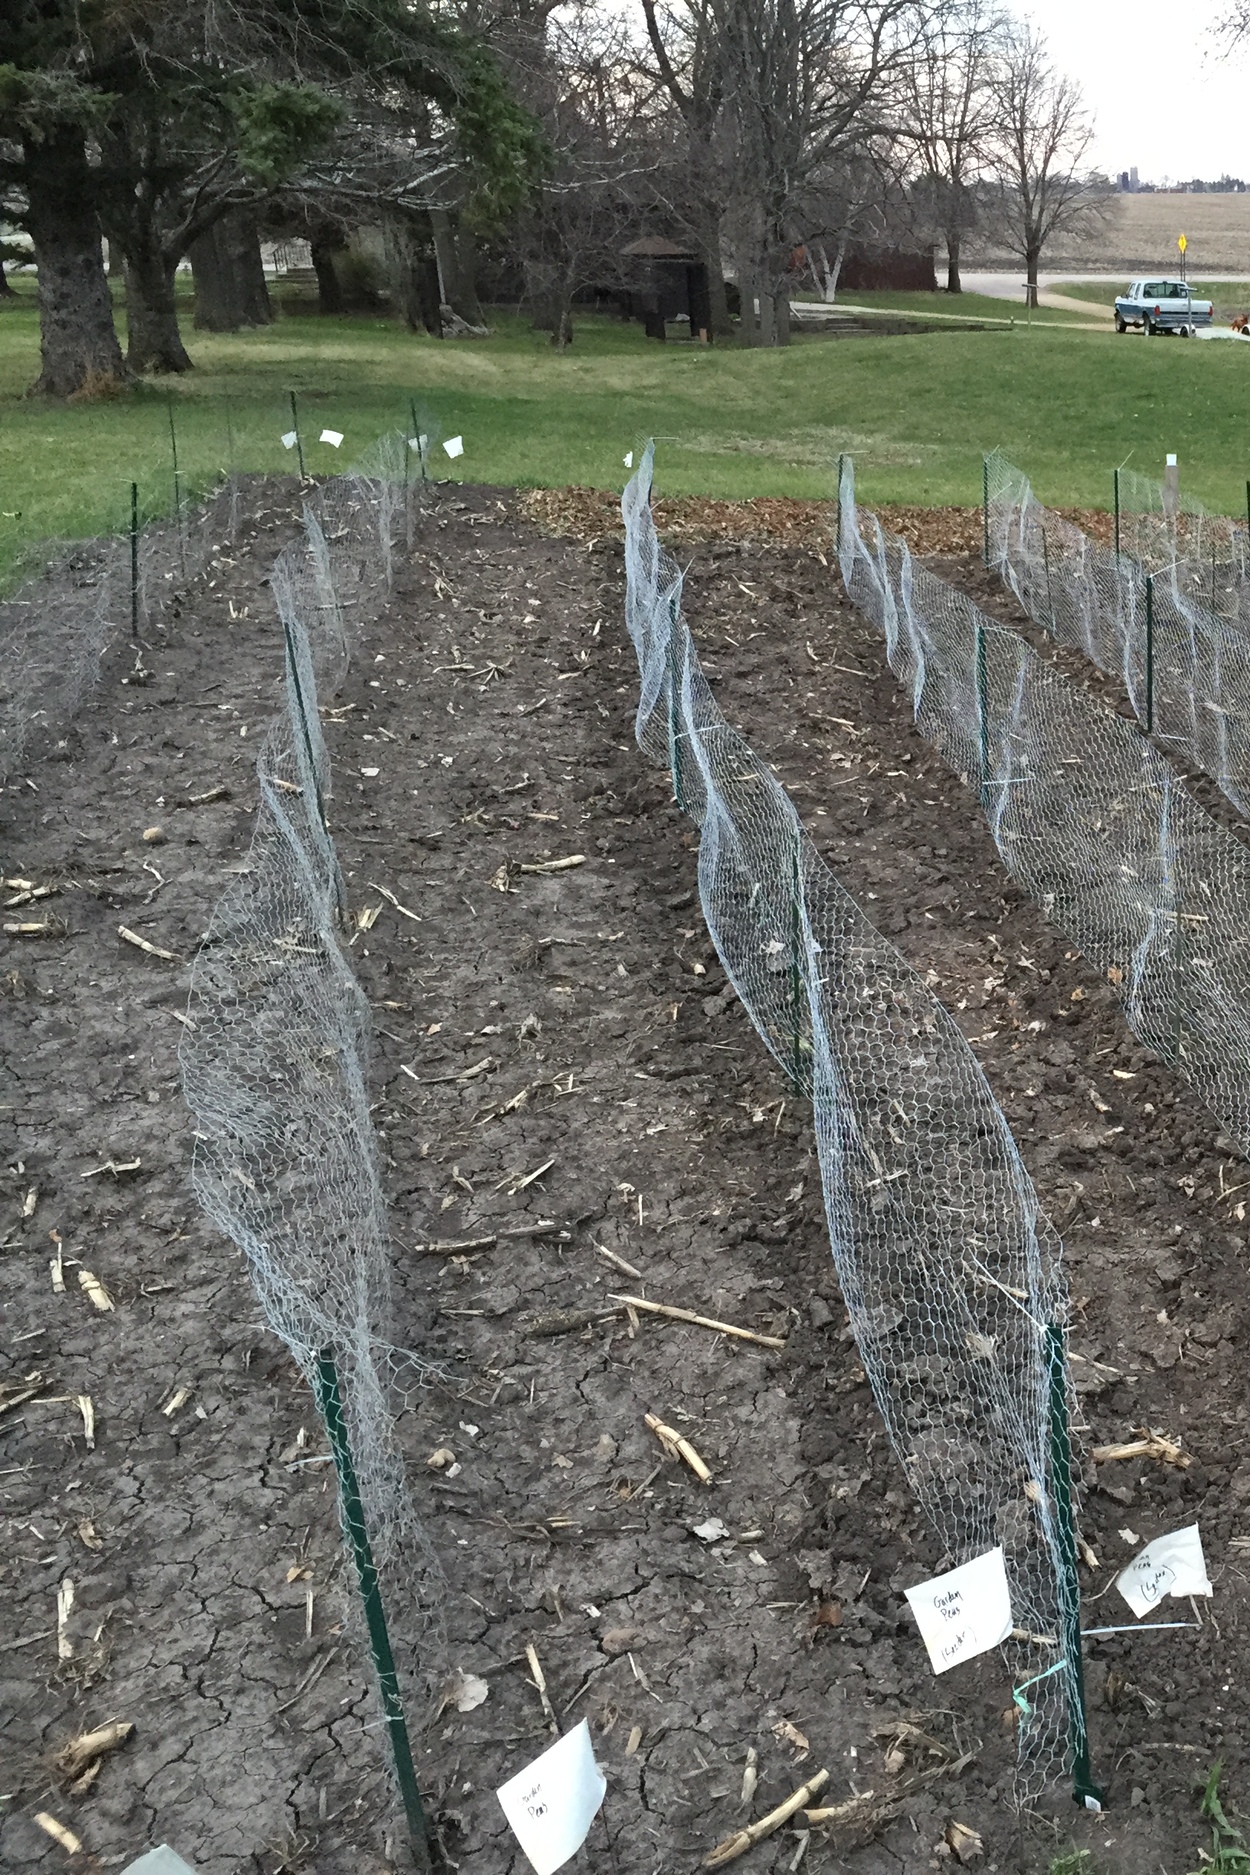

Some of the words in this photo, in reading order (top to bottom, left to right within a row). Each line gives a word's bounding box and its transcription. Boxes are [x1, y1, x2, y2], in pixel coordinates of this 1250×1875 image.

[933, 1590, 964, 1609] Garden
[940, 1606, 961, 1622] Peas
[527, 1801, 549, 1820] Peas
